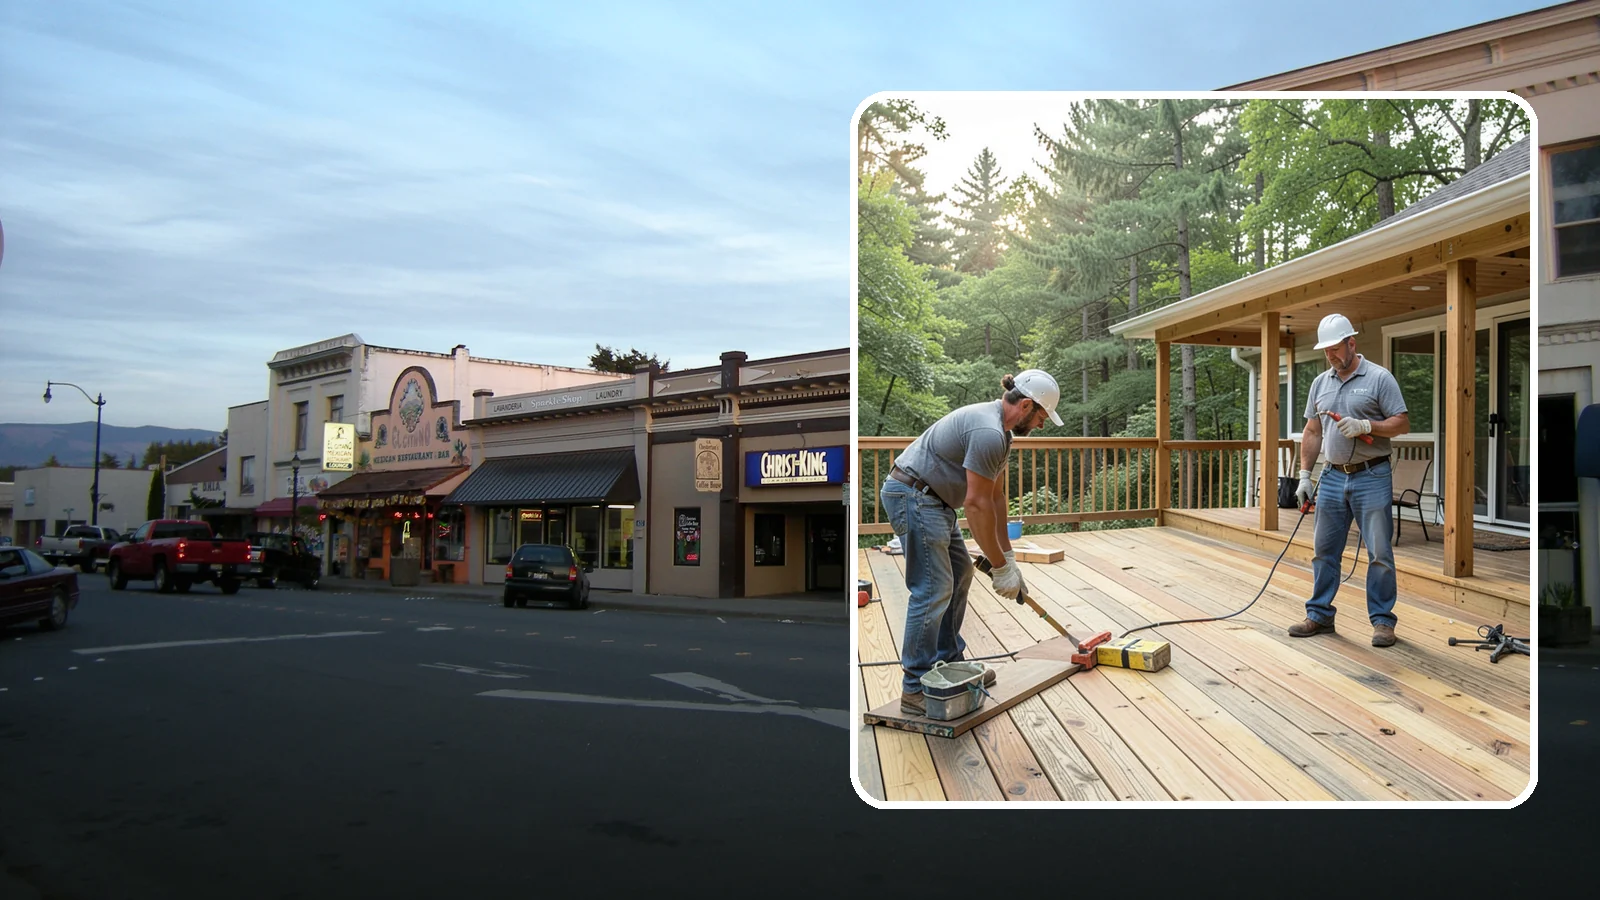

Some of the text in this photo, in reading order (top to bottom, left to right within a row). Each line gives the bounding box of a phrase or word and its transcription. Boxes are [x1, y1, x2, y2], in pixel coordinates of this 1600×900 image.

[493, 389, 623, 412] LAVANDERIA Sparkle Shop LAUNDRY
[373, 455, 396, 464] MEXICAN
[397, 451, 433, 462] RESTAURANT
[437, 450, 450, 459] BAR
[761, 450, 827, 478] CHRIST KING
